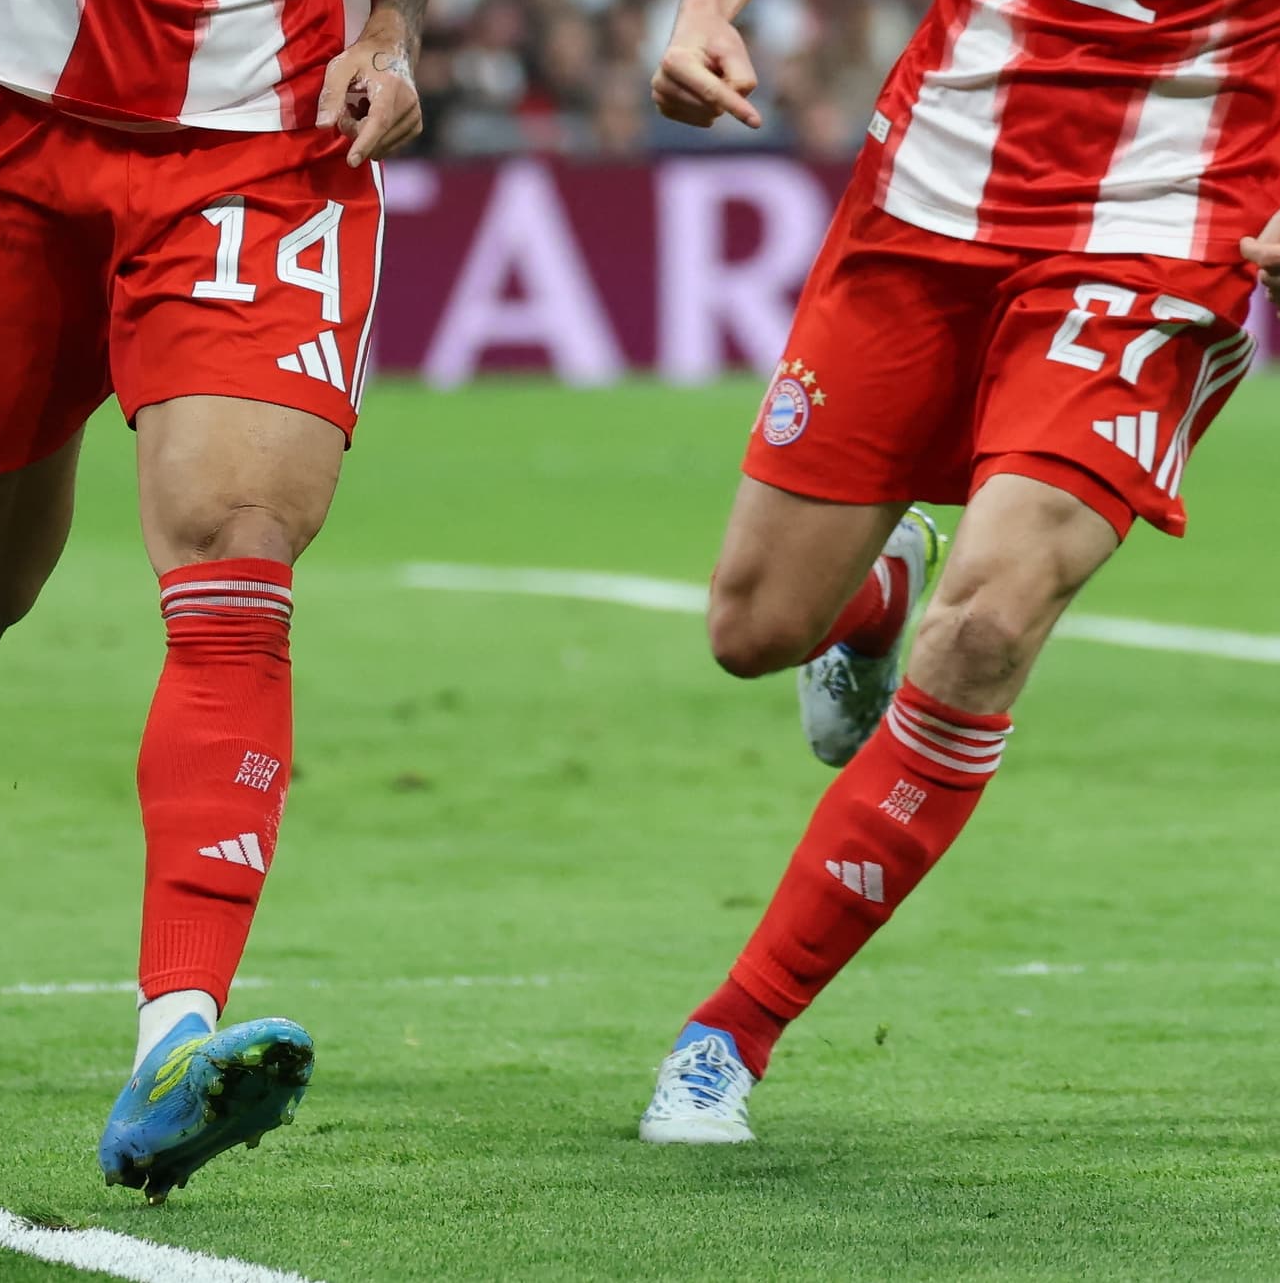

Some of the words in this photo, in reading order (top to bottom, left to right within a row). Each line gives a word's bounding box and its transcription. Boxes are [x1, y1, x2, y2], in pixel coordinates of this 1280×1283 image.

[191, 194, 345, 324] 14
[1045, 281, 1218, 386] 27
[239, 761, 274, 782] SAN
[243, 750, 280, 769] MIA
[234, 771, 270, 793] MIA
[893, 778, 927, 803] MIA
[878, 799, 912, 825] MIA
